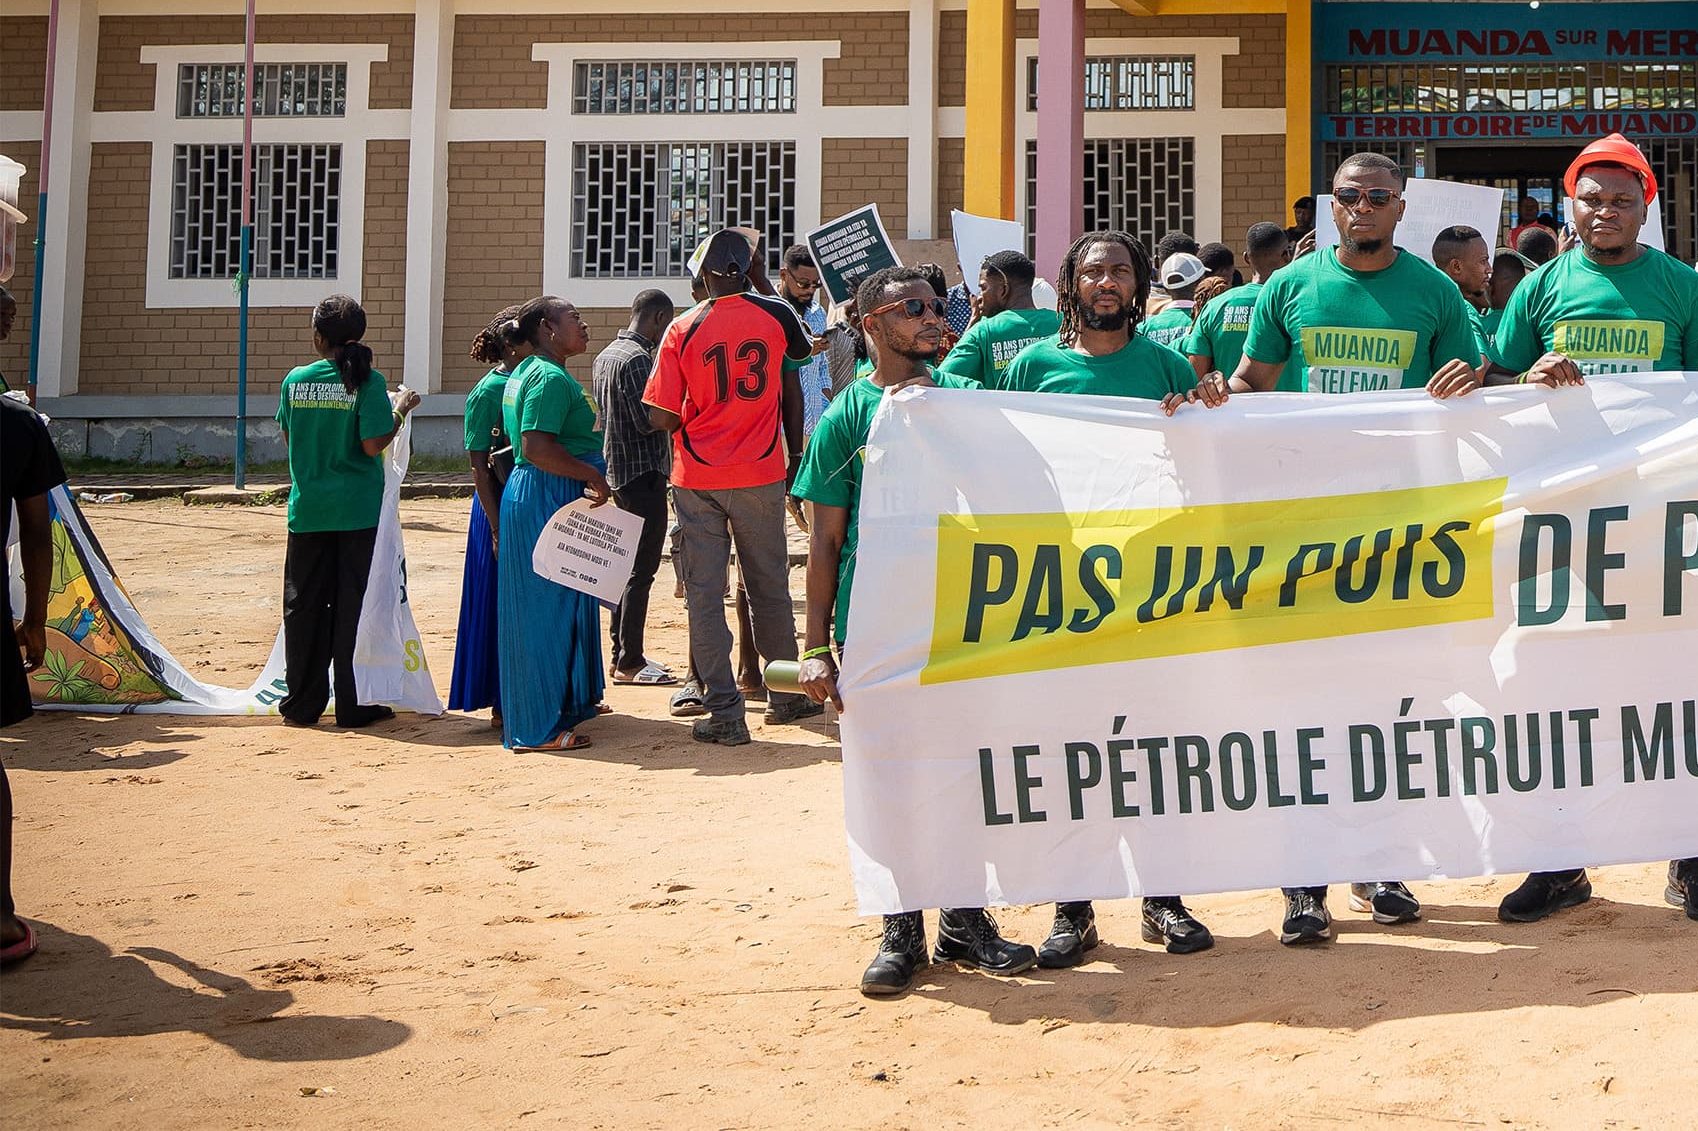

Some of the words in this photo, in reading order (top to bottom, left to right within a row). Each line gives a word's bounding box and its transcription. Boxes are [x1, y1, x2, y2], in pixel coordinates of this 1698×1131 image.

[1348, 29, 1552, 56] MUANDA
[1555, 30, 1597, 45] SUR
[1329, 115, 1531, 138] TERRITOIRE
[1532, 114, 1558, 128] DE
[1235, 306, 1248, 315] ANS
[992, 342, 1002, 352] 50
[1003, 340, 1018, 350] ANS
[1314, 332, 1400, 365] MUANDA
[1565, 326, 1649, 356] MUANDA
[702, 338, 769, 404] 13
[963, 543, 1123, 643] PAS
[1136, 545, 1264, 624] UN
[1278, 521, 1471, 607] PUIS
[1517, 504, 1630, 627] DE
[978, 745, 1048, 826] LE
[1064, 716, 1329, 821] PÉTROLE
[1347, 697, 1599, 803] DÉTRUIT
